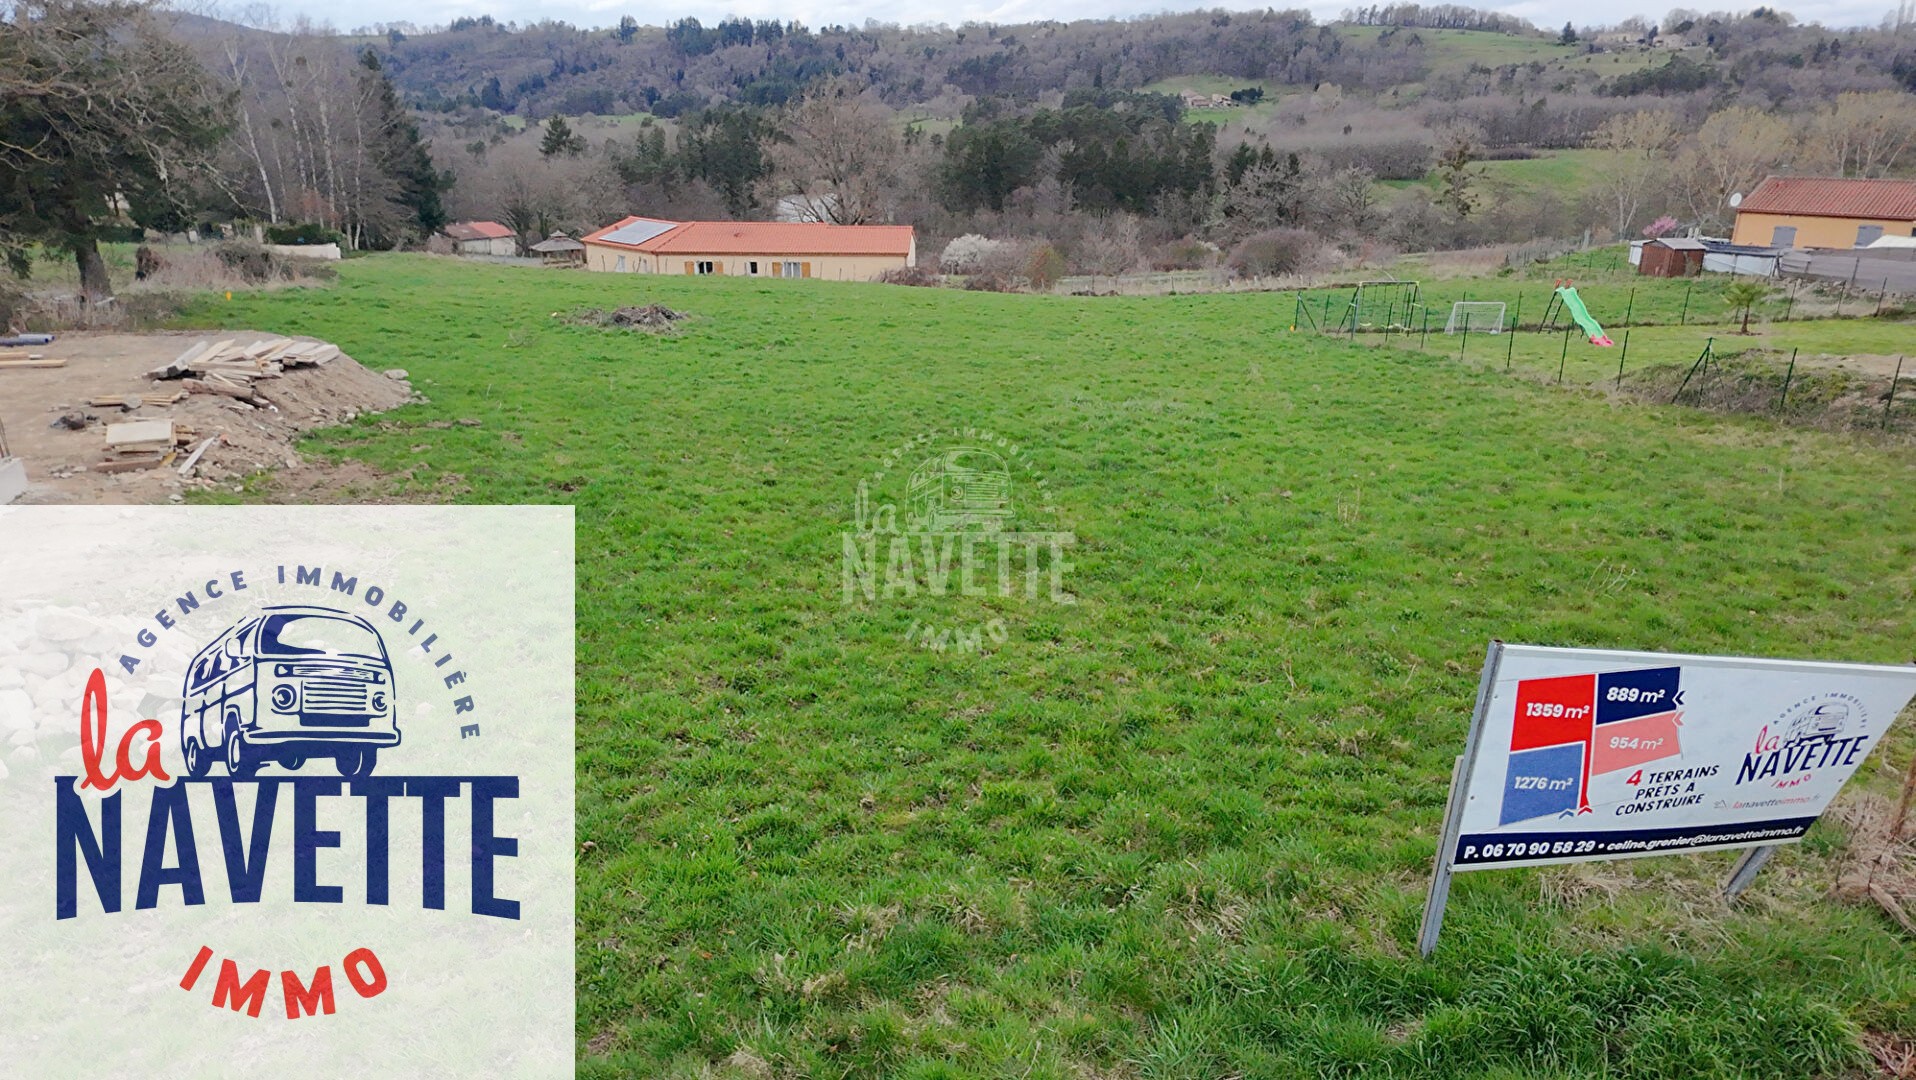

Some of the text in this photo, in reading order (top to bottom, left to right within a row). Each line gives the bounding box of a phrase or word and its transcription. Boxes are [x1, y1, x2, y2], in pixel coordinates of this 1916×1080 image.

[1606, 687, 1639, 702] 889
[1526, 703, 1562, 717] 1359
[1609, 736, 1638, 749] 954
[1755, 725, 1780, 754] la
[1735, 735, 1869, 785] NAVETTE
[1514, 776, 1547, 790] 1276
[1626, 765, 1720, 786] 4 TERRAINS
[1771, 774, 1812, 789] IMMO
[1615, 794, 1704, 816] CONSTRUIRE
[1463, 846, 1479, 859] P.
[1482, 843, 1504, 857] 06
[1506, 843, 1525, 856] 70
[1528, 842, 1550, 855] 90
[1551, 841, 1574, 854] 58
[1574, 840, 1596, 853] 29
